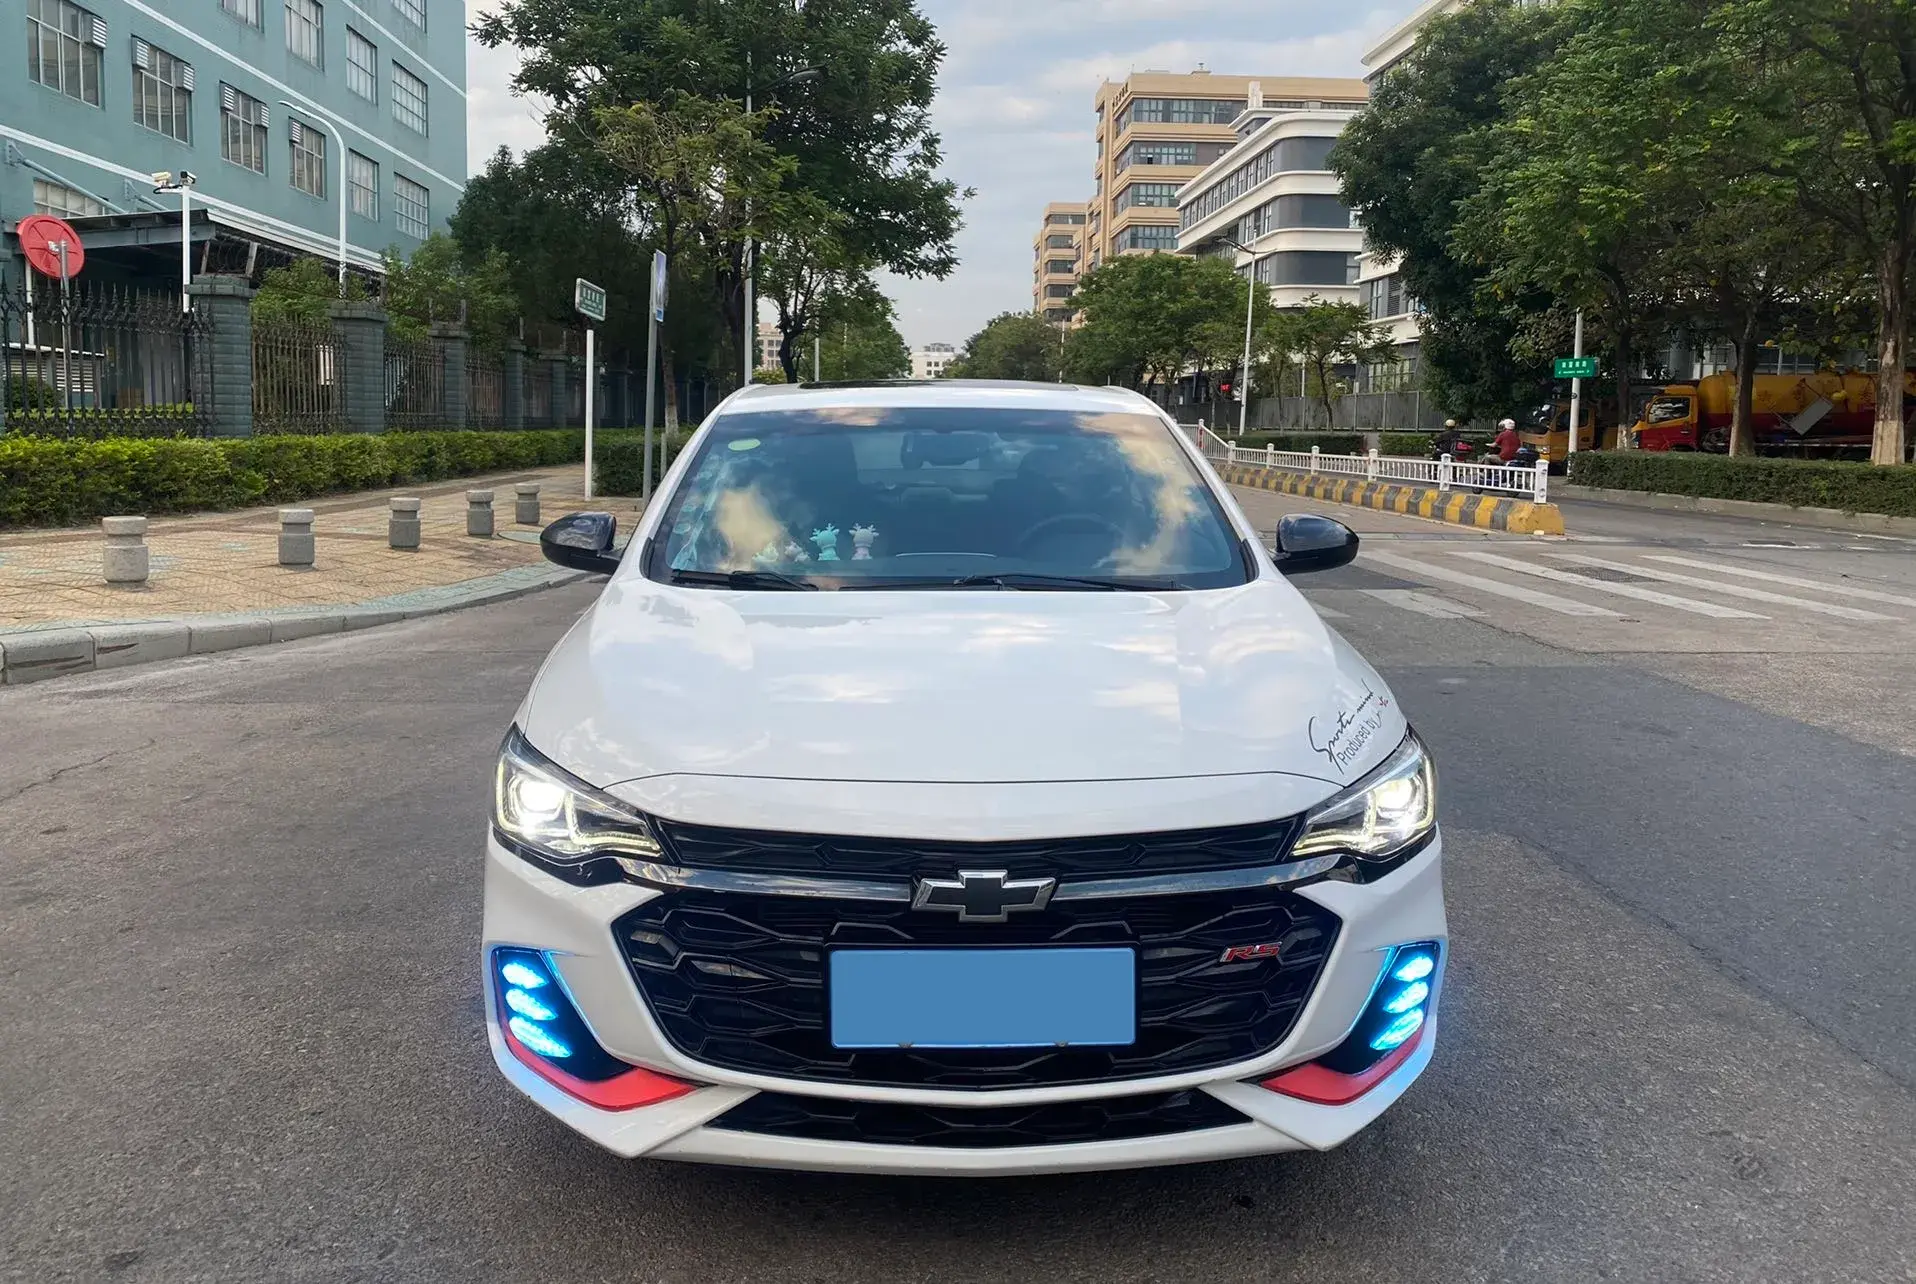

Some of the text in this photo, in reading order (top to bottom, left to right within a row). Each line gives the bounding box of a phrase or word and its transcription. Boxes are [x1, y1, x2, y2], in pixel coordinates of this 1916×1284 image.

[1336, 711, 1382, 766] Produced by
[1219, 942, 1283, 963] RS
